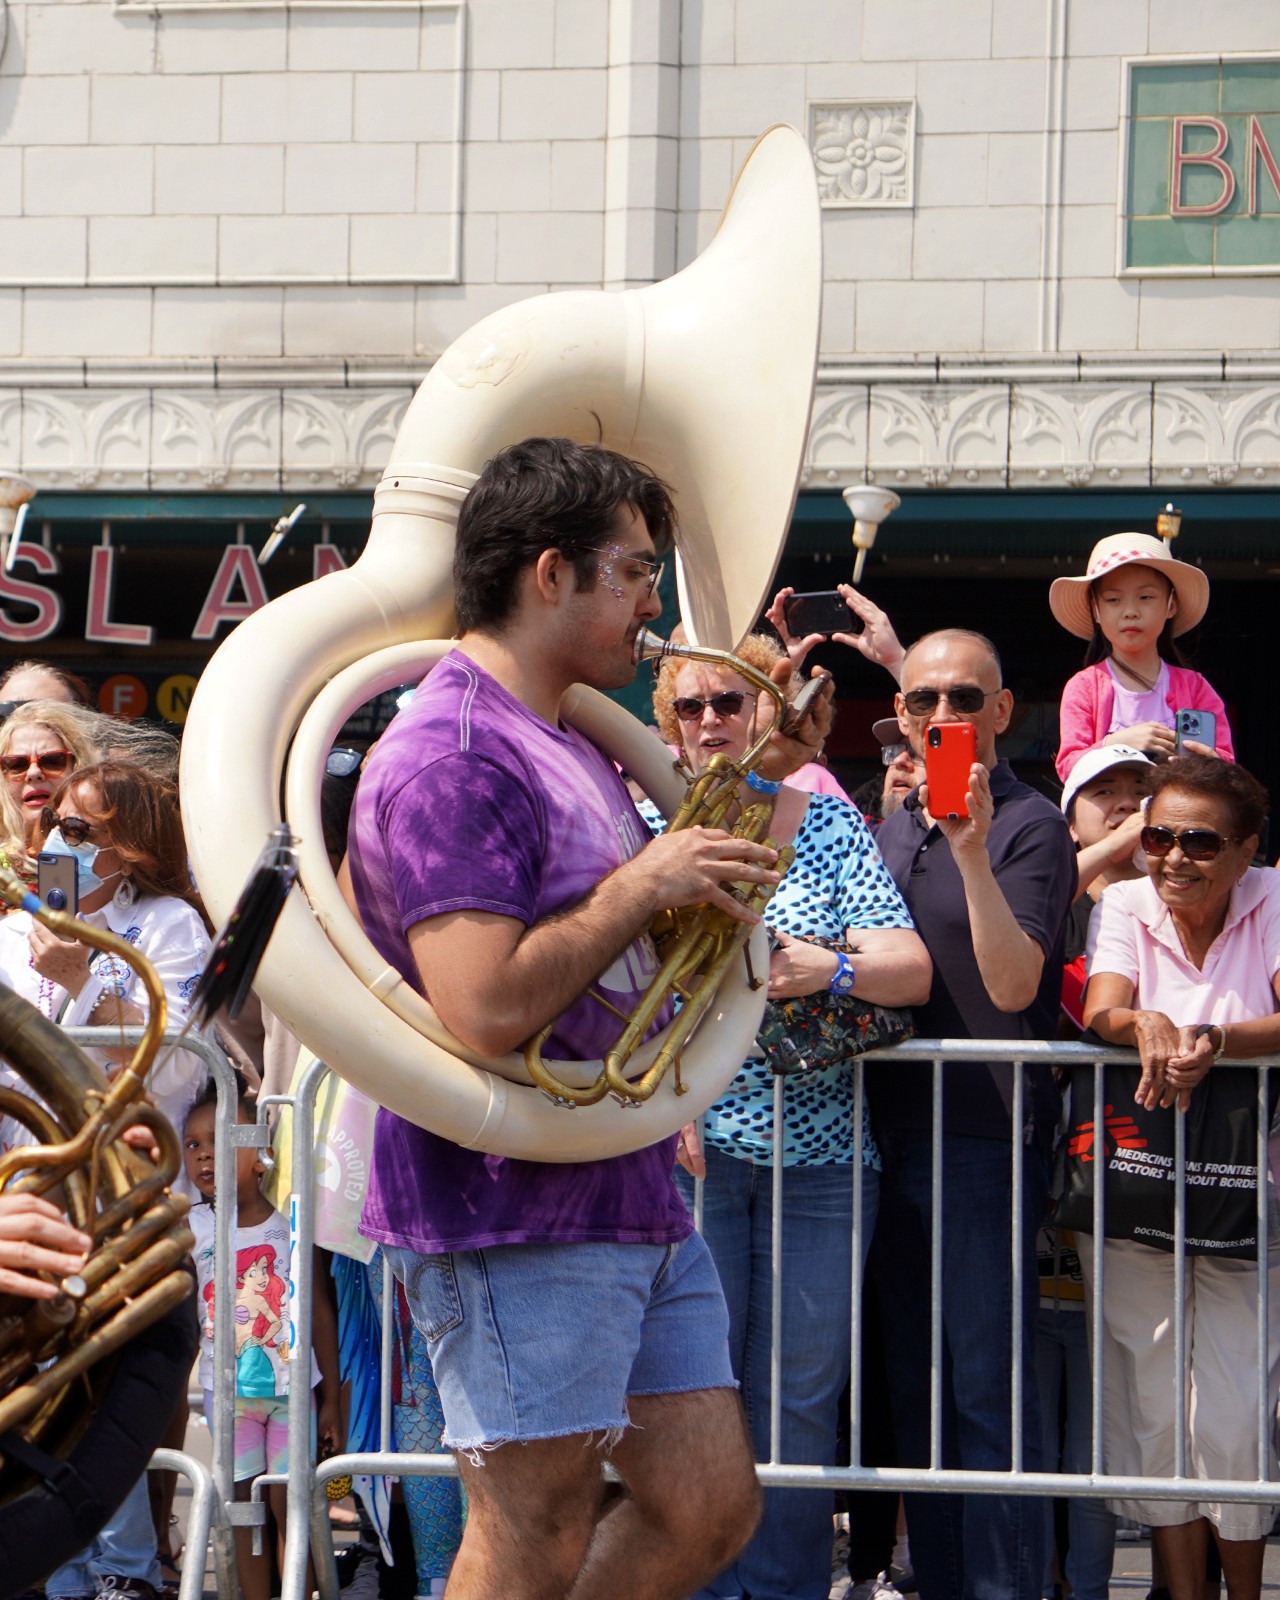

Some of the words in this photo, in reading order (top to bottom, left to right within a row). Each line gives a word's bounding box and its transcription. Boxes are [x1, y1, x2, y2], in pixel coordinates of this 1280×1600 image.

[112, 684, 134, 712] F
[327, 1123, 366, 1202] APPROVED
[1114, 1146, 1173, 1168] MEDECINS
[1108, 1158, 1164, 1180] DOCTORS
[1166, 1170, 1216, 1186] WHOUT
[1133, 1226, 1256, 1249] DOCTORSWHOUTBORDERS.ORG
